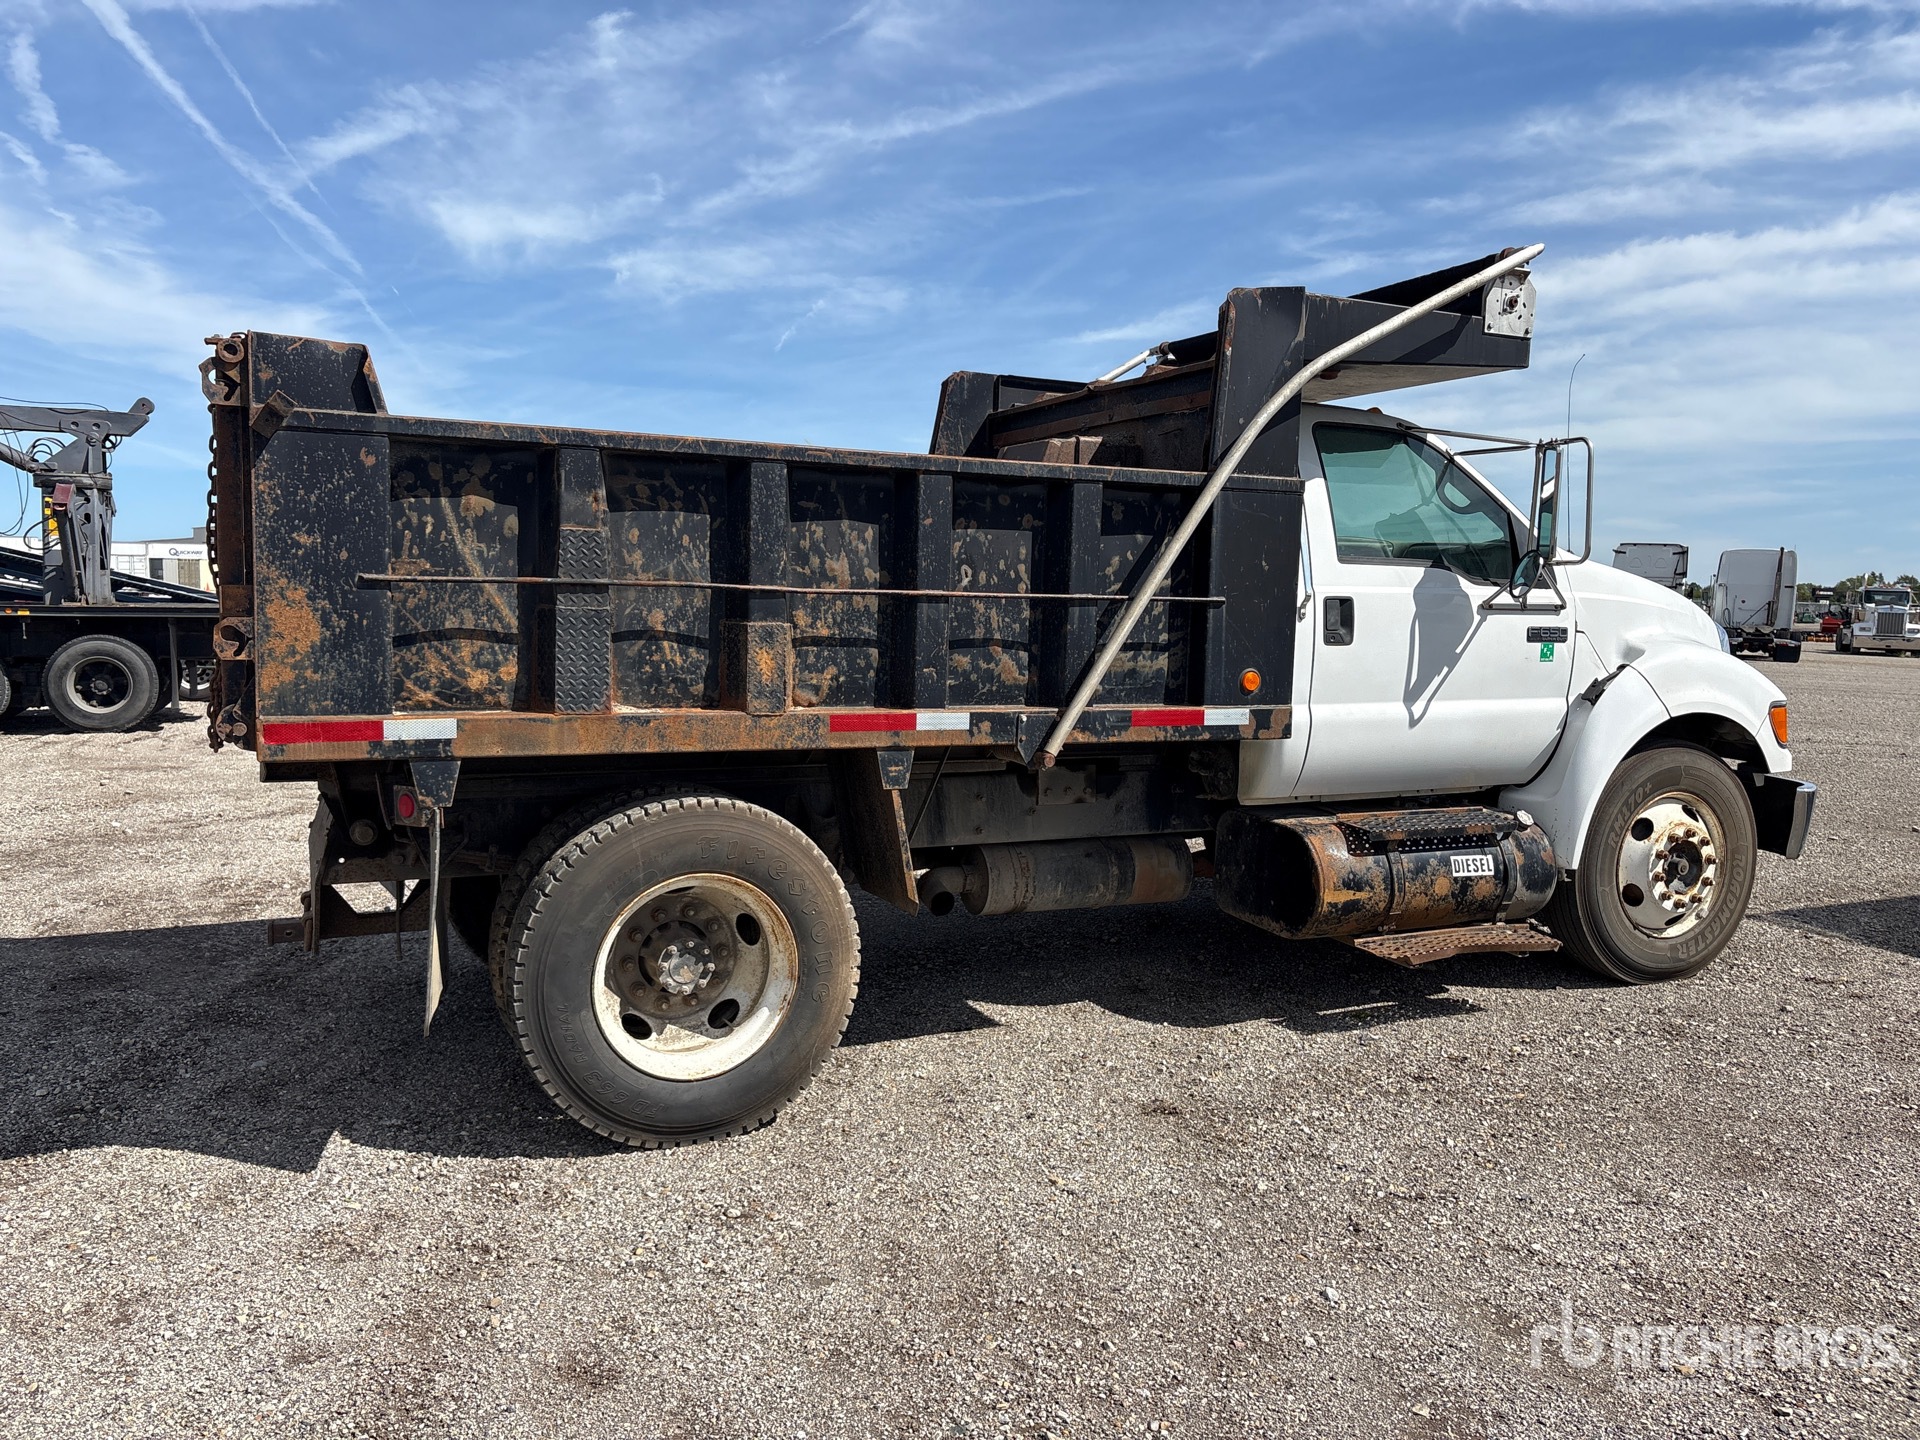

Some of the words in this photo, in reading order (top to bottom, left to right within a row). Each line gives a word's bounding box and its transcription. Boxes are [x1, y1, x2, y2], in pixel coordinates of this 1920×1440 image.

[1452, 857, 1493, 874] DIESEL
[1676, 854, 1746, 959] ROADMASTER
[696, 835, 834, 1004] Firestone
[557, 1002, 589, 1063] RADIAL
